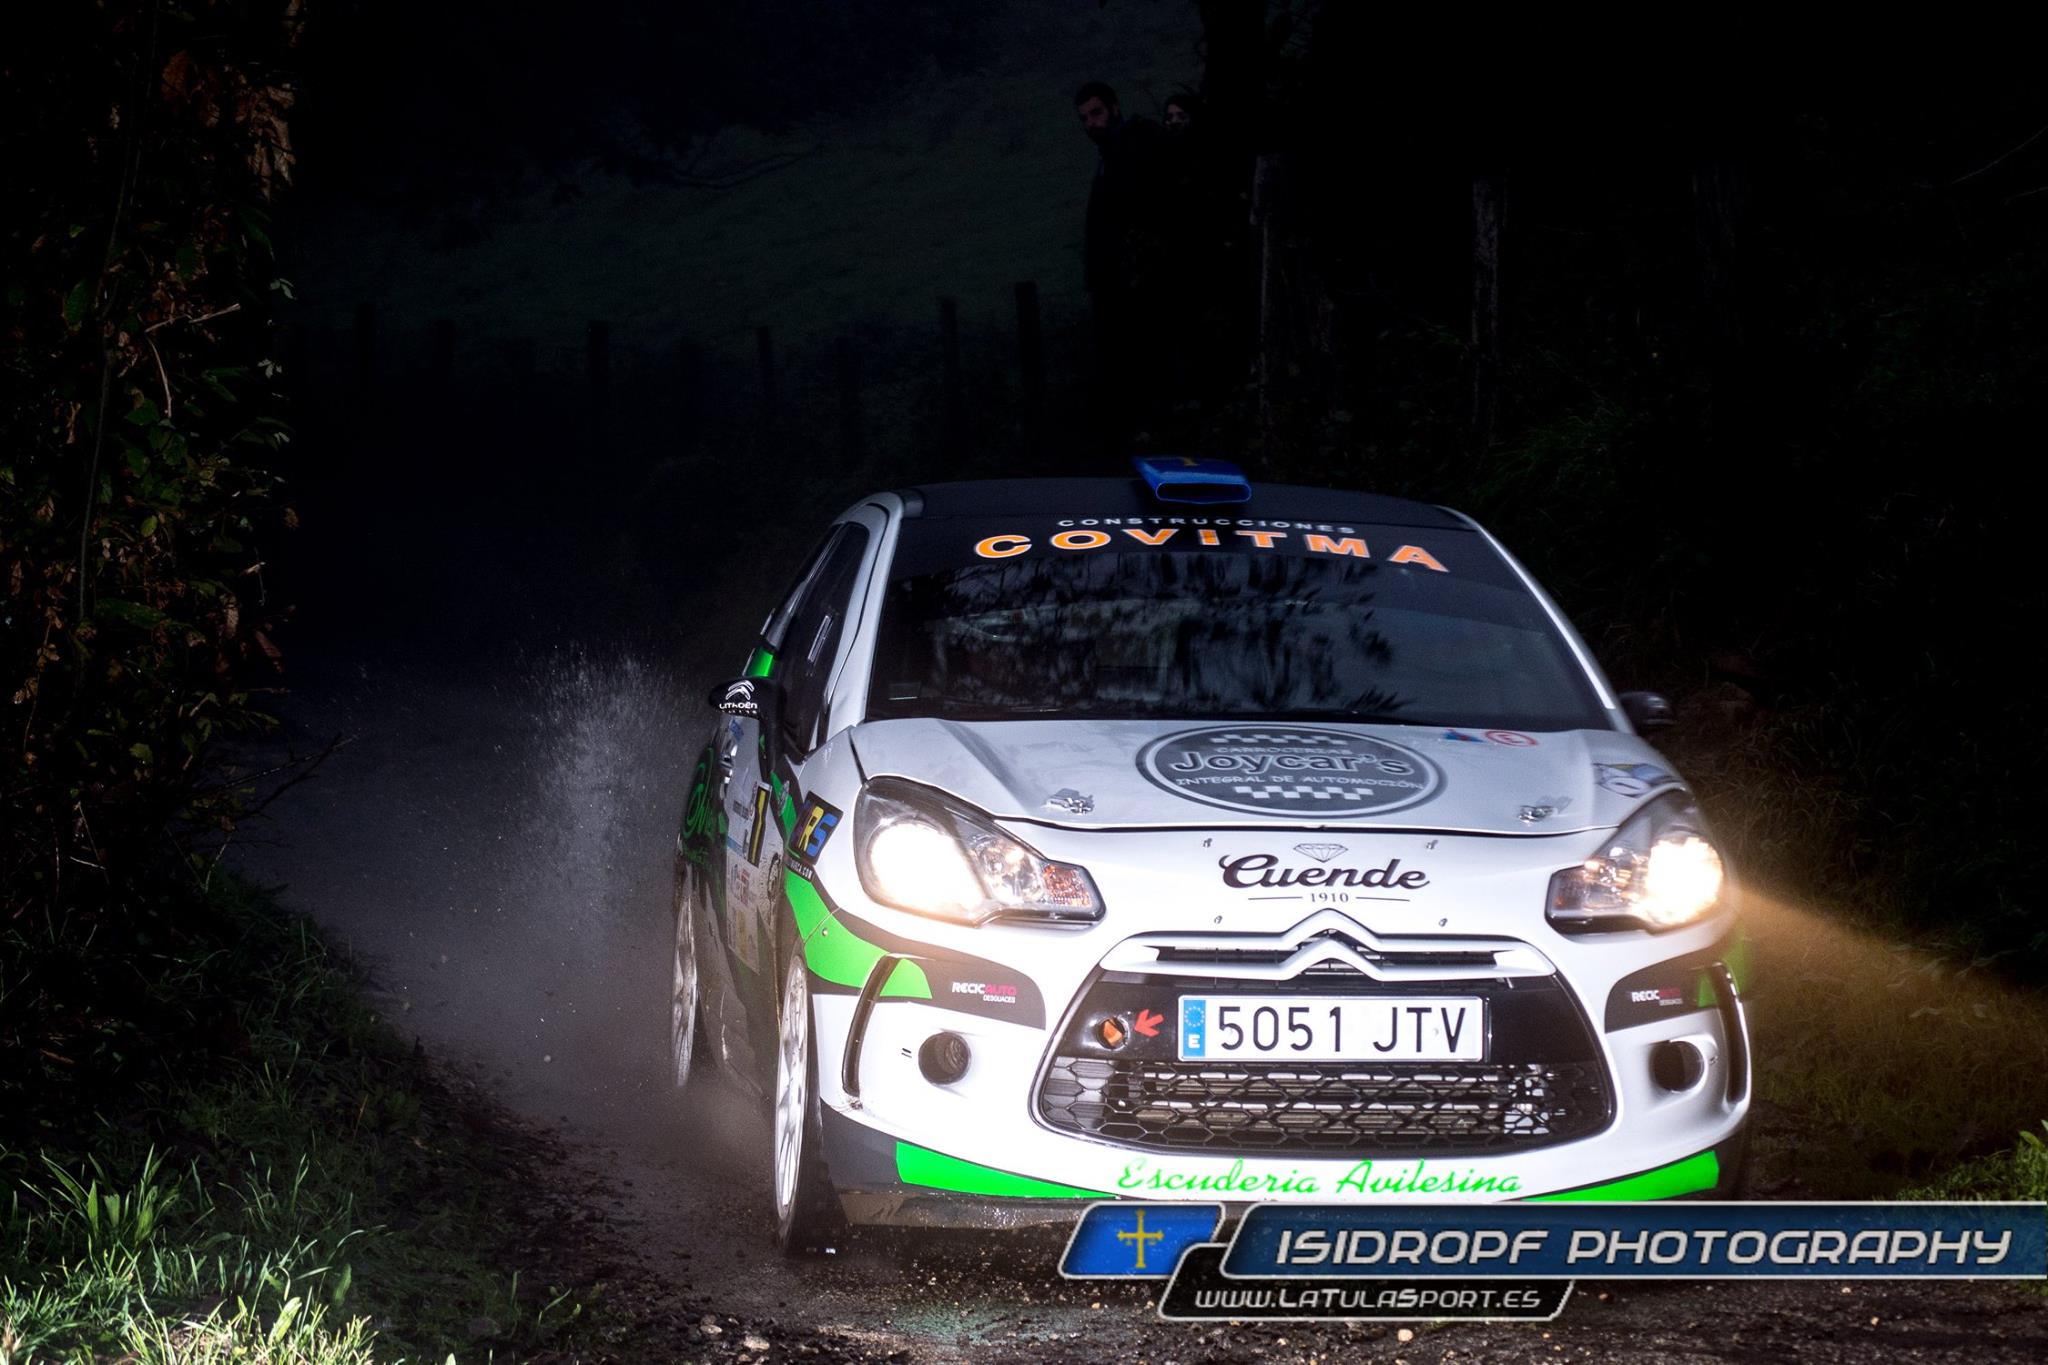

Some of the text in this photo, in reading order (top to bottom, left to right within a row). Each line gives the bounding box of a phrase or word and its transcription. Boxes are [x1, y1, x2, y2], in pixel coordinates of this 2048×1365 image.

[1057, 517, 1355, 534] CONSTRUCCIONES
[974, 528, 1450, 572] COVITMA
[1169, 751, 1416, 775] Joycar's
[1175, 775, 1267, 786] INTEGRAL
[1271, 775, 1294, 783] DE
[1218, 854, 1430, 890] Cuende
[1310, 892, 1349, 903] 1910
[1188, 1006, 1466, 1053] E 5051 JTV
[1117, 1157, 1522, 1194] Escuderia Avilesina
